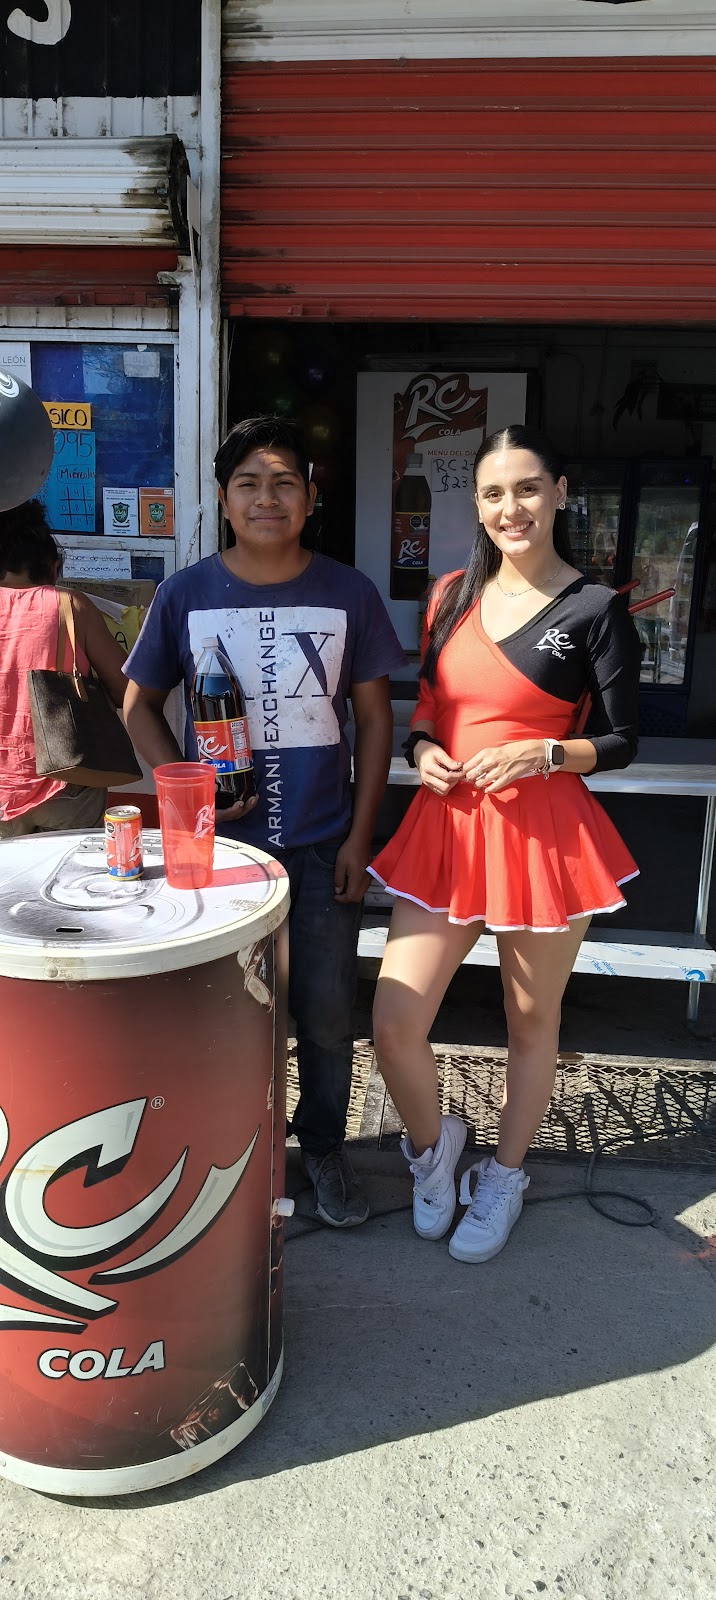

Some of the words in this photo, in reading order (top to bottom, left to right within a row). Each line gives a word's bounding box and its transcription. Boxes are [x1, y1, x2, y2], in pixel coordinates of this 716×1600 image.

[3, 355, 26, 364] LEÓN
[403, 378, 470, 432] RC
[49, 408, 88, 426] SICO
[438, 428, 461, 437] COLA
[427, 448, 448, 456] MENÚ
[398, 539, 424, 560] RC
[535, 628, 572, 650] RC
[281, 632, 335, 699] X
[551, 650, 567, 660] COLA
[260, 610, 280, 743] EXCHANGE
[197, 735, 223, 762] RC
[265, 755, 285, 849] ARMANI
[38, 1340, 165, 1379] COLA
